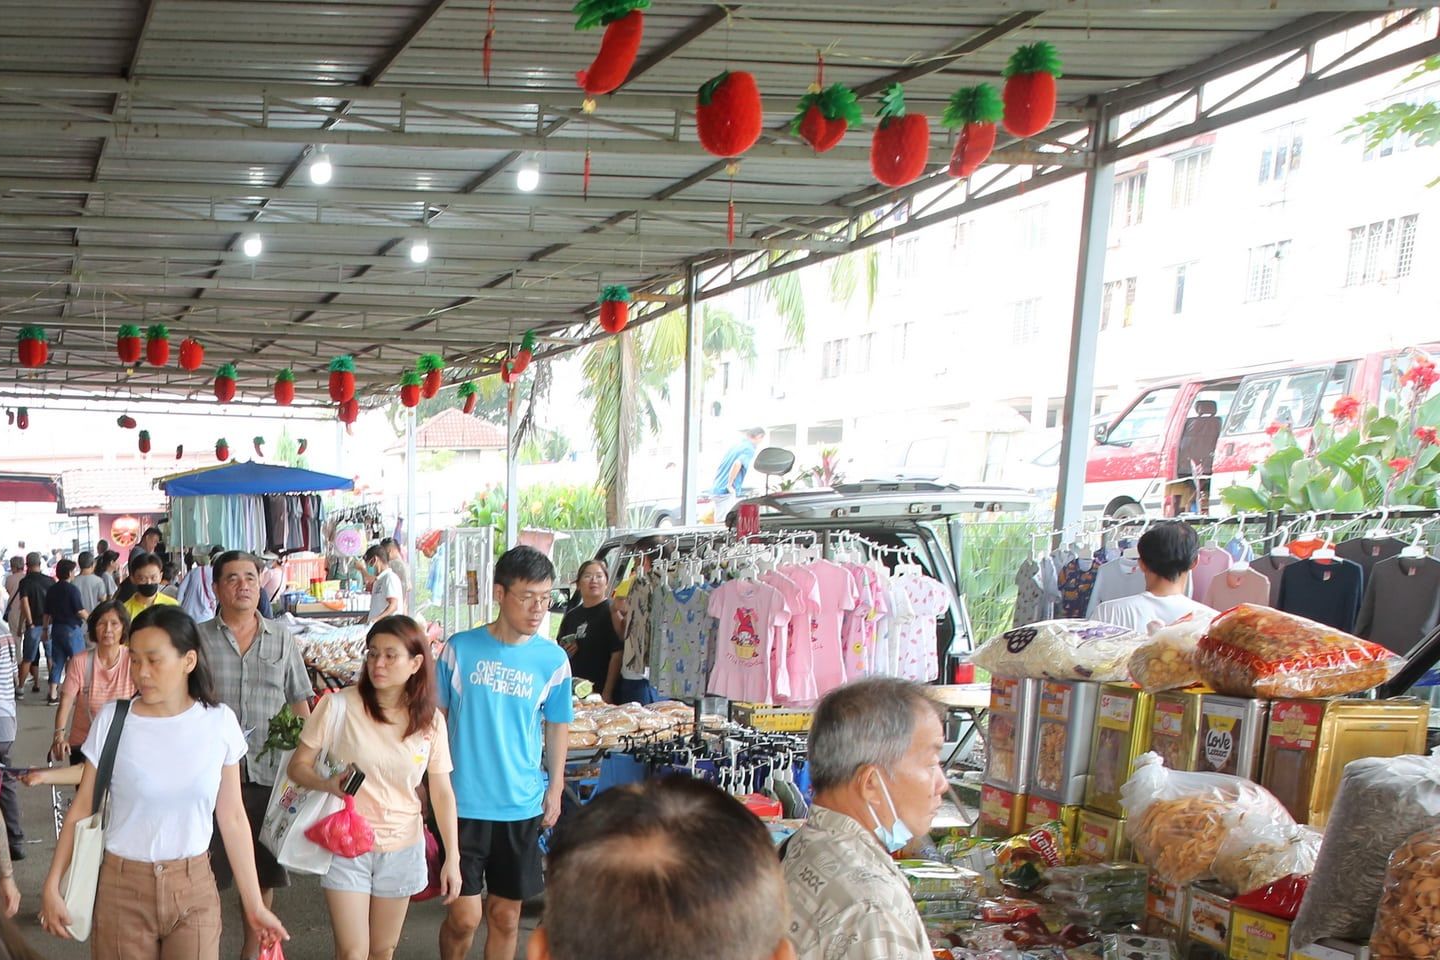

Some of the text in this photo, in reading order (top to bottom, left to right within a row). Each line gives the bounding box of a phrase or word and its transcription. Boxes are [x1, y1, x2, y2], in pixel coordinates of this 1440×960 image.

[469, 671, 533, 699] ONE DREAM
[476, 660, 533, 686] ONE TEAM
[1207, 731, 1231, 750] Love
